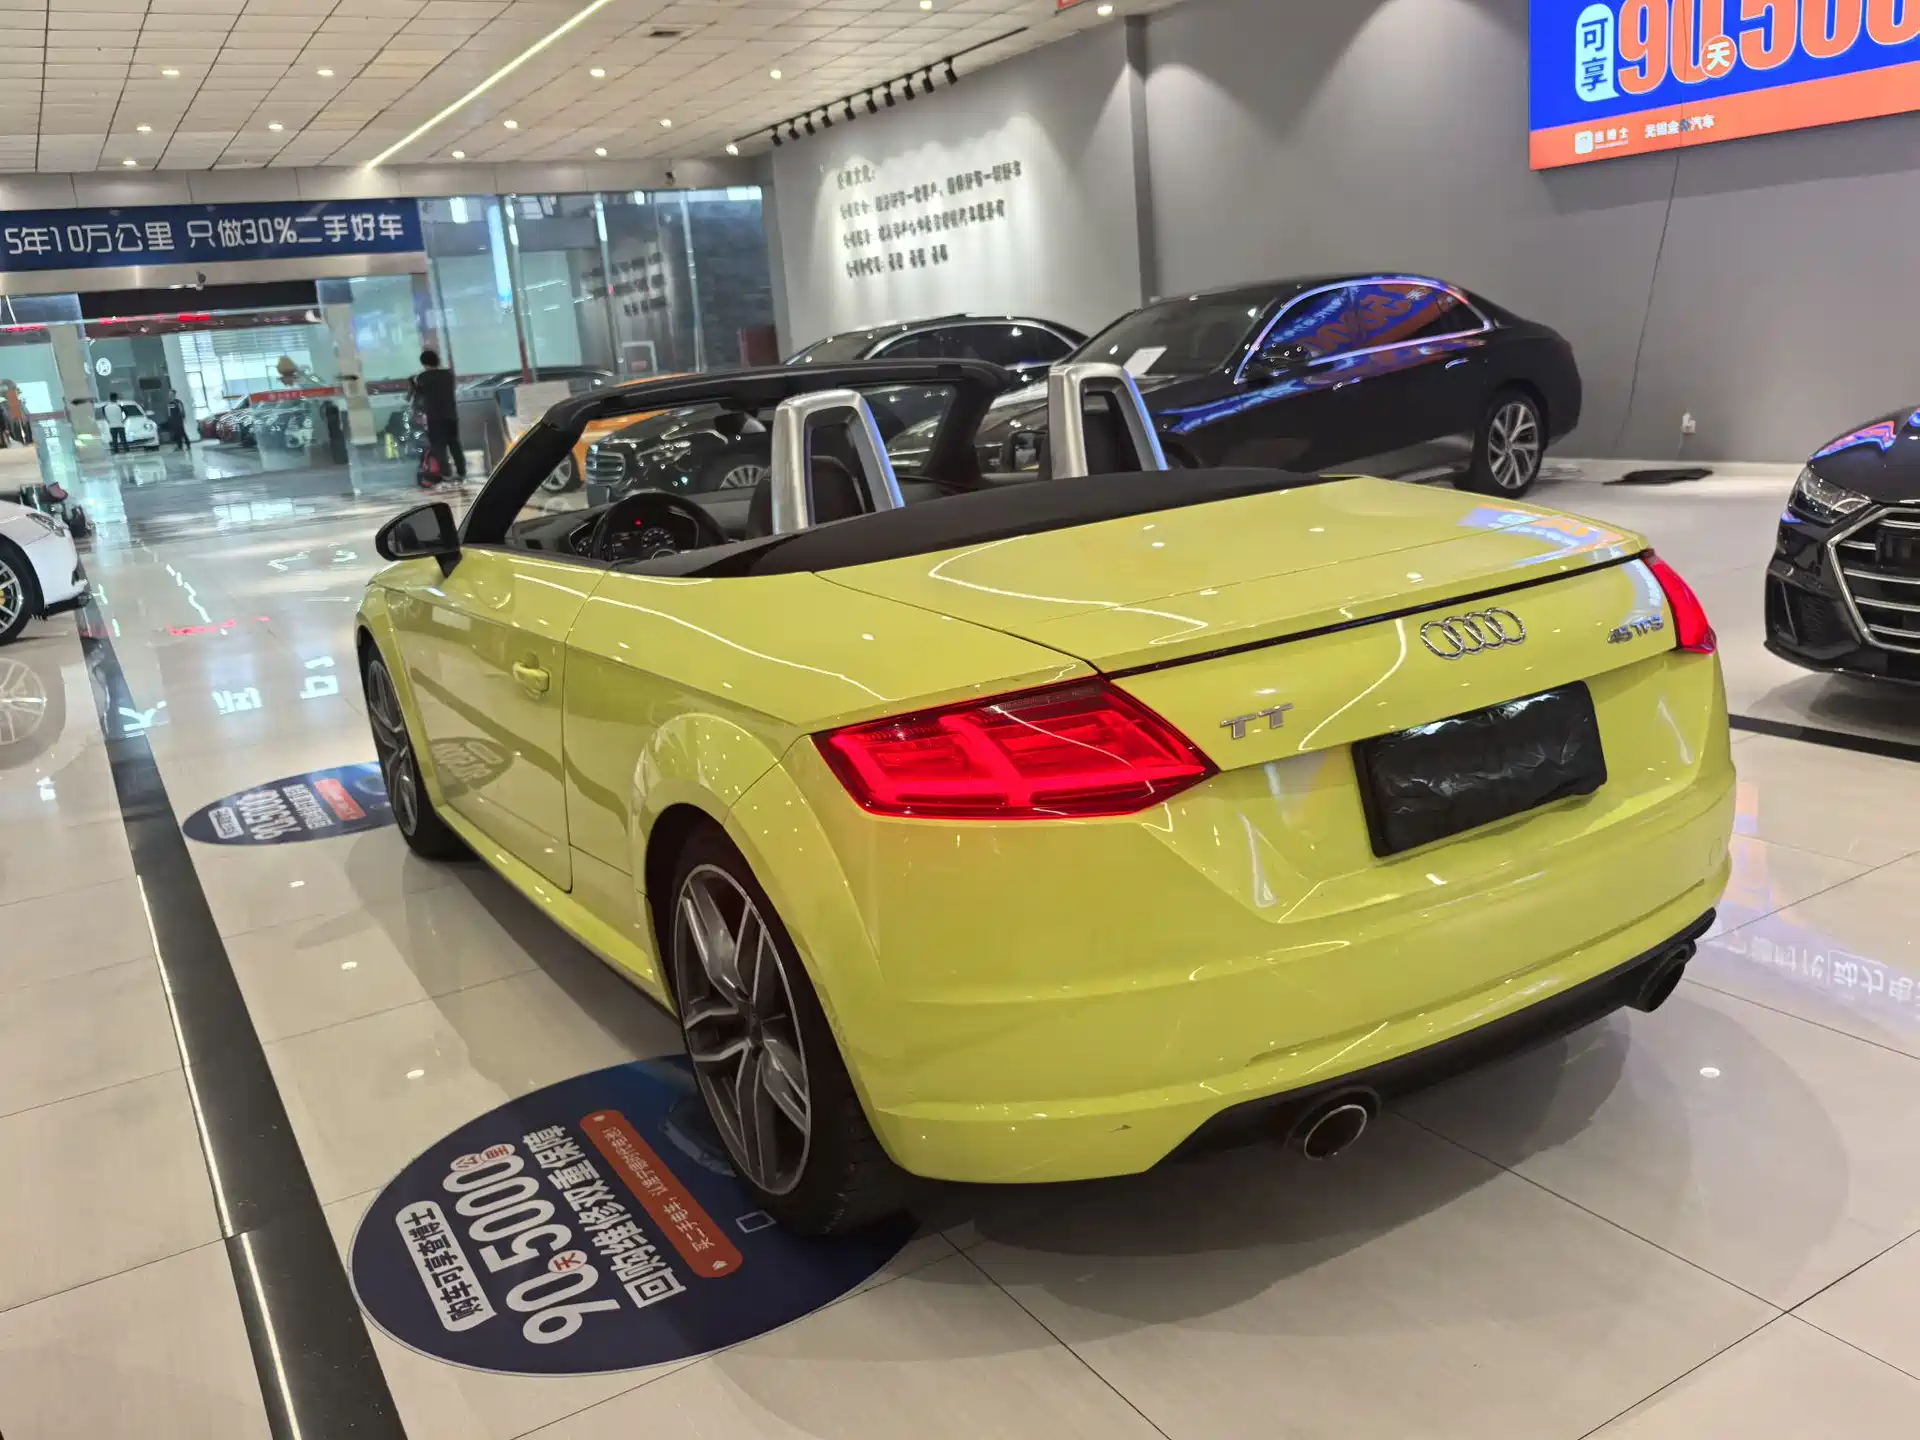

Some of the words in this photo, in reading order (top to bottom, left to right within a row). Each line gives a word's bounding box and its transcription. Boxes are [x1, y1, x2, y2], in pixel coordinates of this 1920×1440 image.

[1580, 17, 1610, 93] 可享
[4, 220, 176, 256] 5年10万公里
[186, 212, 404, 250] 只做30%二手好车
[1606, 624, 1633, 644] 45
[1219, 702, 1295, 741] TT
[522, 1123, 688, 1309] 回购维修双重保障
[403, 1206, 485, 1323] 购车可享查博士
